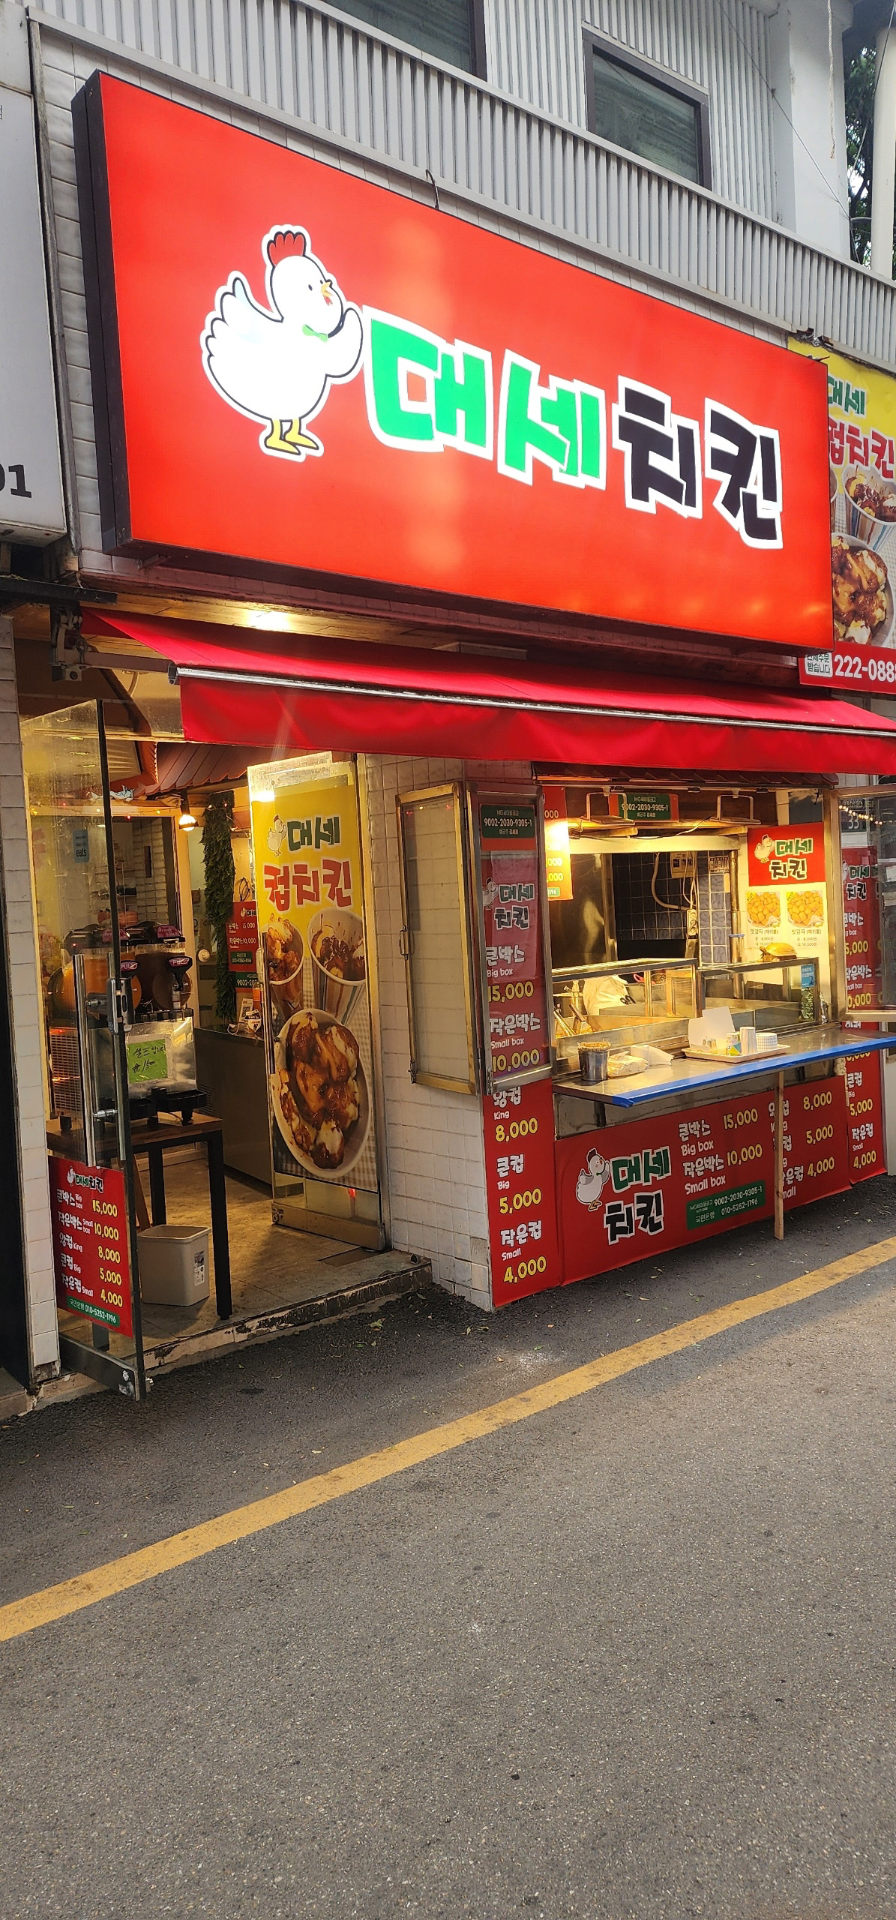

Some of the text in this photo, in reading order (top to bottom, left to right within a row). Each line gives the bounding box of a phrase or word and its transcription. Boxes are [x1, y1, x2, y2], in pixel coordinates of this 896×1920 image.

[828, 374, 868, 418] 대세
[364, 306, 784, 548] 대세치킨
[0, 462, 33, 499] 1
[807, 662, 832, 675] 받습니다
[834, 653, 896, 683] 222-088
[285, 815, 342, 853] 대세
[775, 838, 814, 857] 대세
[769, 858, 808, 880] 치킨
[262, 857, 353, 913] 컵치킨
[498, 883, 535, 904] 대세
[494, 905, 530, 930] 치킨
[486, 945, 525, 966] 큰박스
[845, 940, 869, 956] 5,000
[486, 968, 514, 978] Big box
[847, 992, 872, 1008] 0,000
[490, 1012, 541, 1036] 작은박스
[491, 1037, 525, 1050] Small box
[492, 1049, 540, 1072] 10,000
[493, 1086, 521, 1108] 왕컵
[803, 1091, 832, 1111] 8,000
[493, 1111, 510, 1120] King
[850, 1099, 873, 1117] 5,000
[495, 1117, 539, 1142] 8,000
[679, 1108, 759, 1141] 큰박스 15,000
[806, 1124, 833, 1144] 5,000
[852, 1122, 873, 1141] 작은컵
[681, 1140, 714, 1156] Big box
[497, 1153, 524, 1178] 큰컵
[610, 1146, 671, 1193] 대세
[683, 1154, 724, 1178] 작은박스
[727, 1144, 763, 1166] 10,000
[853, 1150, 877, 1169] 4,000
[783, 1165, 804, 1187] 은컵
[807, 1156, 835, 1177] 4,000
[497, 1180, 510, 1190] Big
[684, 1175, 726, 1195] Small box
[92, 1199, 118, 1218] 15,000
[499, 1188, 542, 1214] 5,000
[604, 1189, 664, 1245] 치킨
[94, 1222, 119, 1241] 10,000
[500, 1220, 542, 1247] 작은컵
[98, 1245, 121, 1264] 8,000
[501, 1248, 521, 1261] Small
[100, 1267, 122, 1286] 5,000
[503, 1256, 547, 1283] 4,000
[101, 1289, 123, 1307] 4,000
